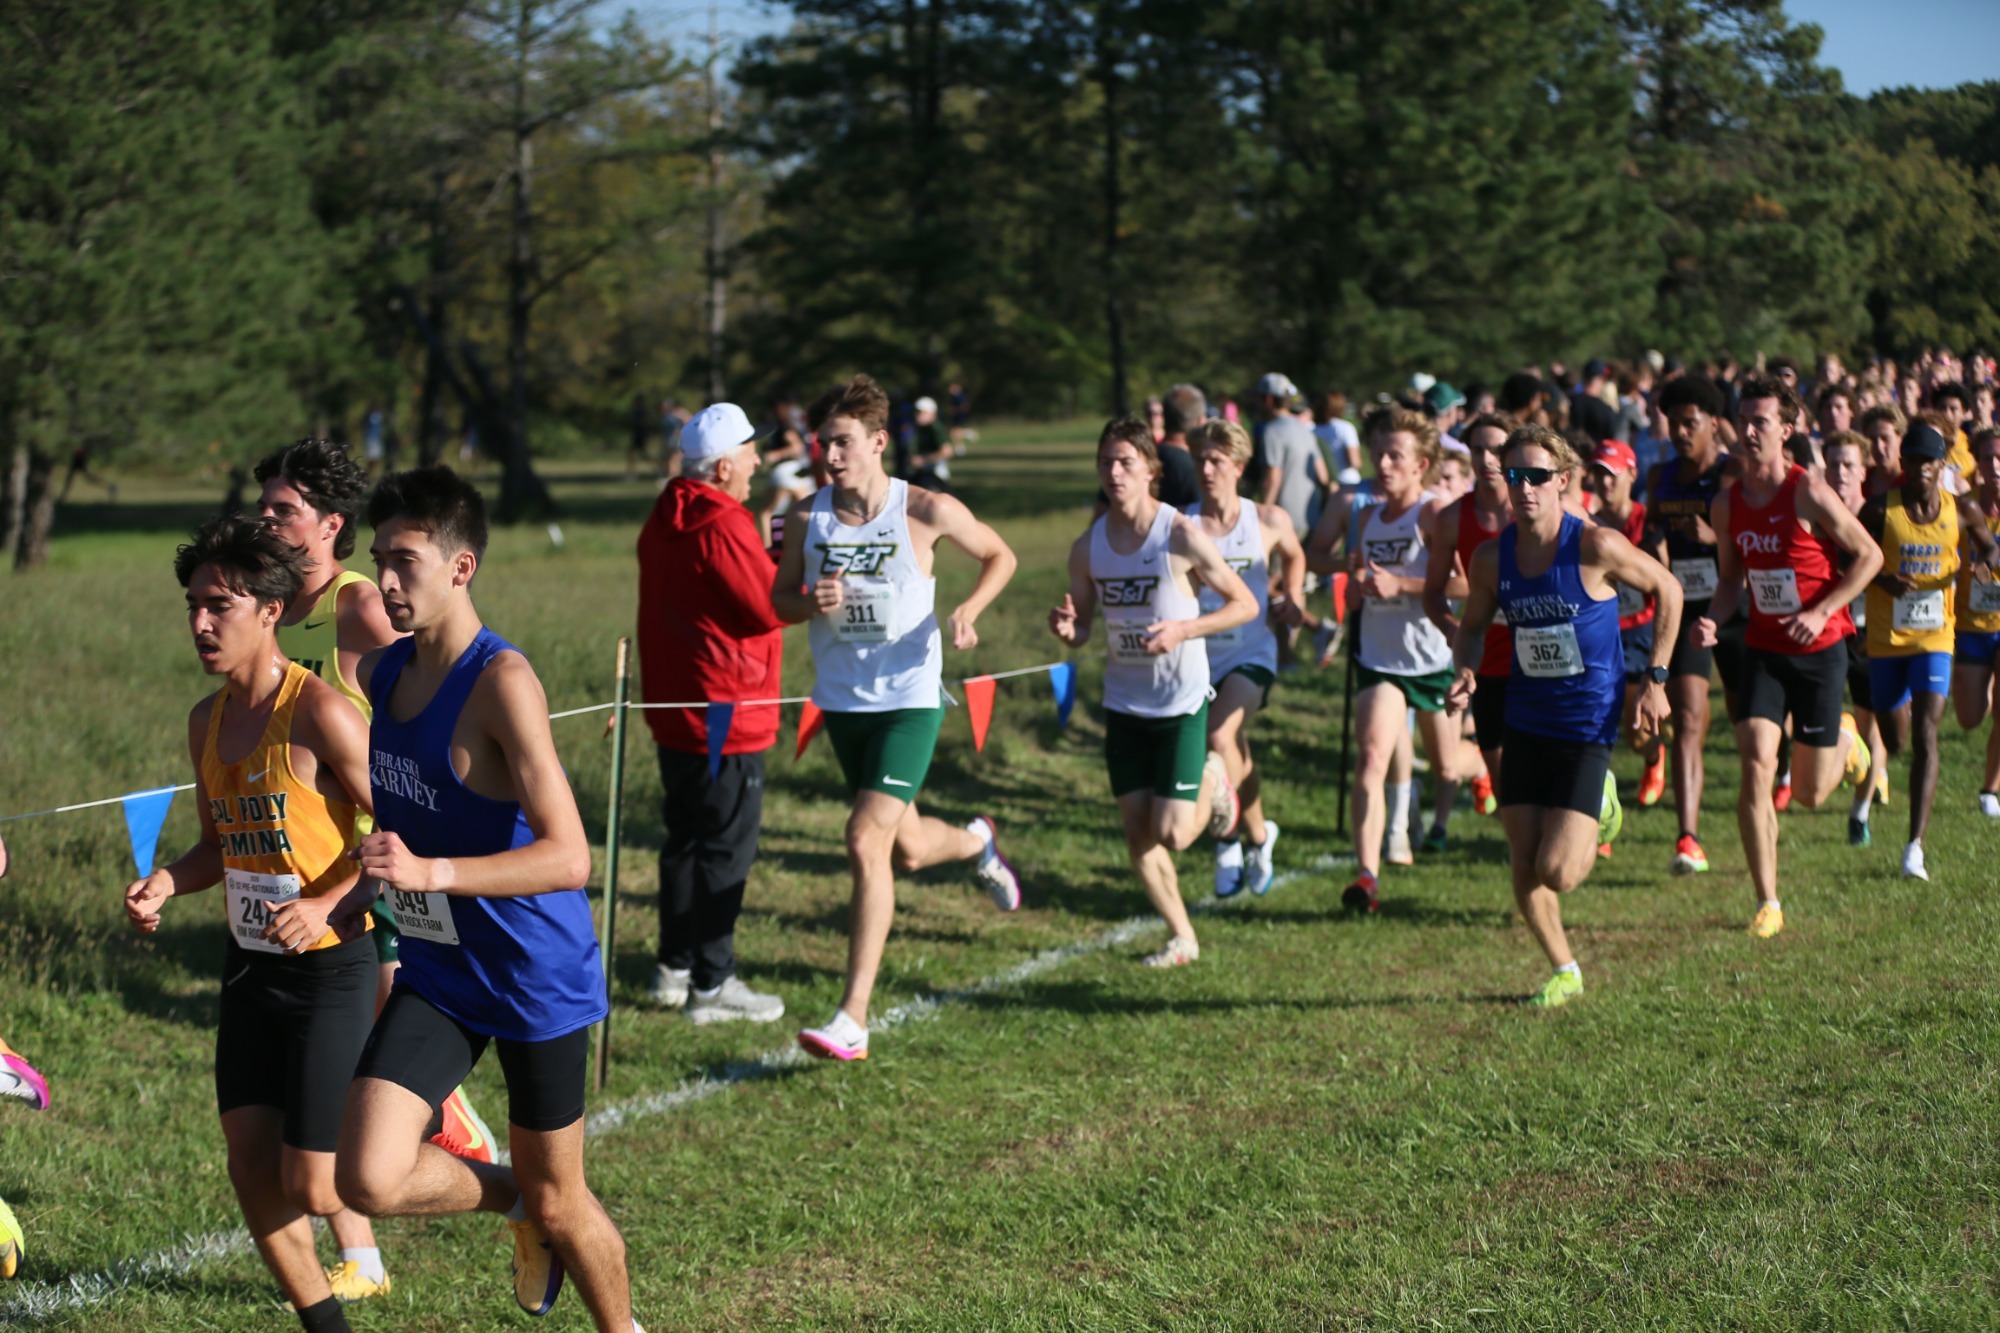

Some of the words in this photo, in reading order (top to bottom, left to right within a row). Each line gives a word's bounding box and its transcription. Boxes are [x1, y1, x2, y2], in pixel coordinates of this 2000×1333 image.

[1737, 530, 1780, 557] Pitt
[814, 543, 897, 576] S&T
[1097, 576, 1160, 607] S&T
[1510, 595, 1565, 608] NEBRASKA
[1760, 584, 1782, 600] 397
[845, 604, 876, 624] 311
[1508, 603, 1580, 622] KEARNEY
[1530, 643, 1563, 662] 362
[374, 749, 420, 780] EBRASKA
[369, 764, 438, 811] KARNEY
[237, 792, 287, 823] POLY
[394, 888, 430, 916] 349
[236, 925, 249, 937] RIM
[248, 927, 263, 939] ROC
[404, 915, 424, 929] ROCK
[422, 918, 444, 932] FARM
